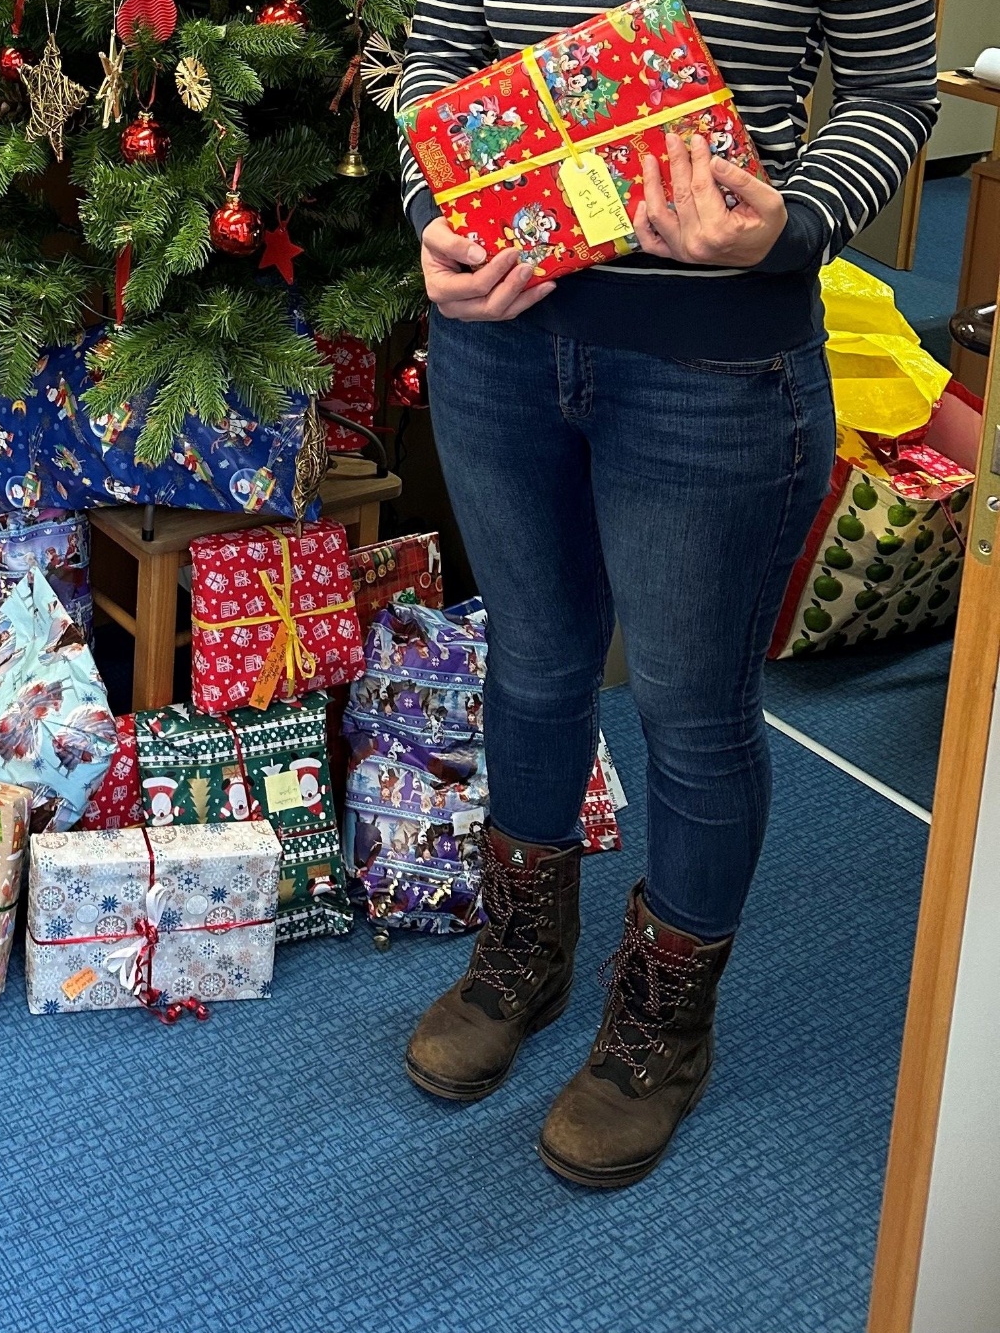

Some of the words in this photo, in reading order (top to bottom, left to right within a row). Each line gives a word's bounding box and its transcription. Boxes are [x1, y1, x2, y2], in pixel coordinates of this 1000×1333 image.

[416, 142, 443, 188] CHRISTMAS
[423, 137, 457, 184] MERRY
[609, 206, 630, 231] Junge
